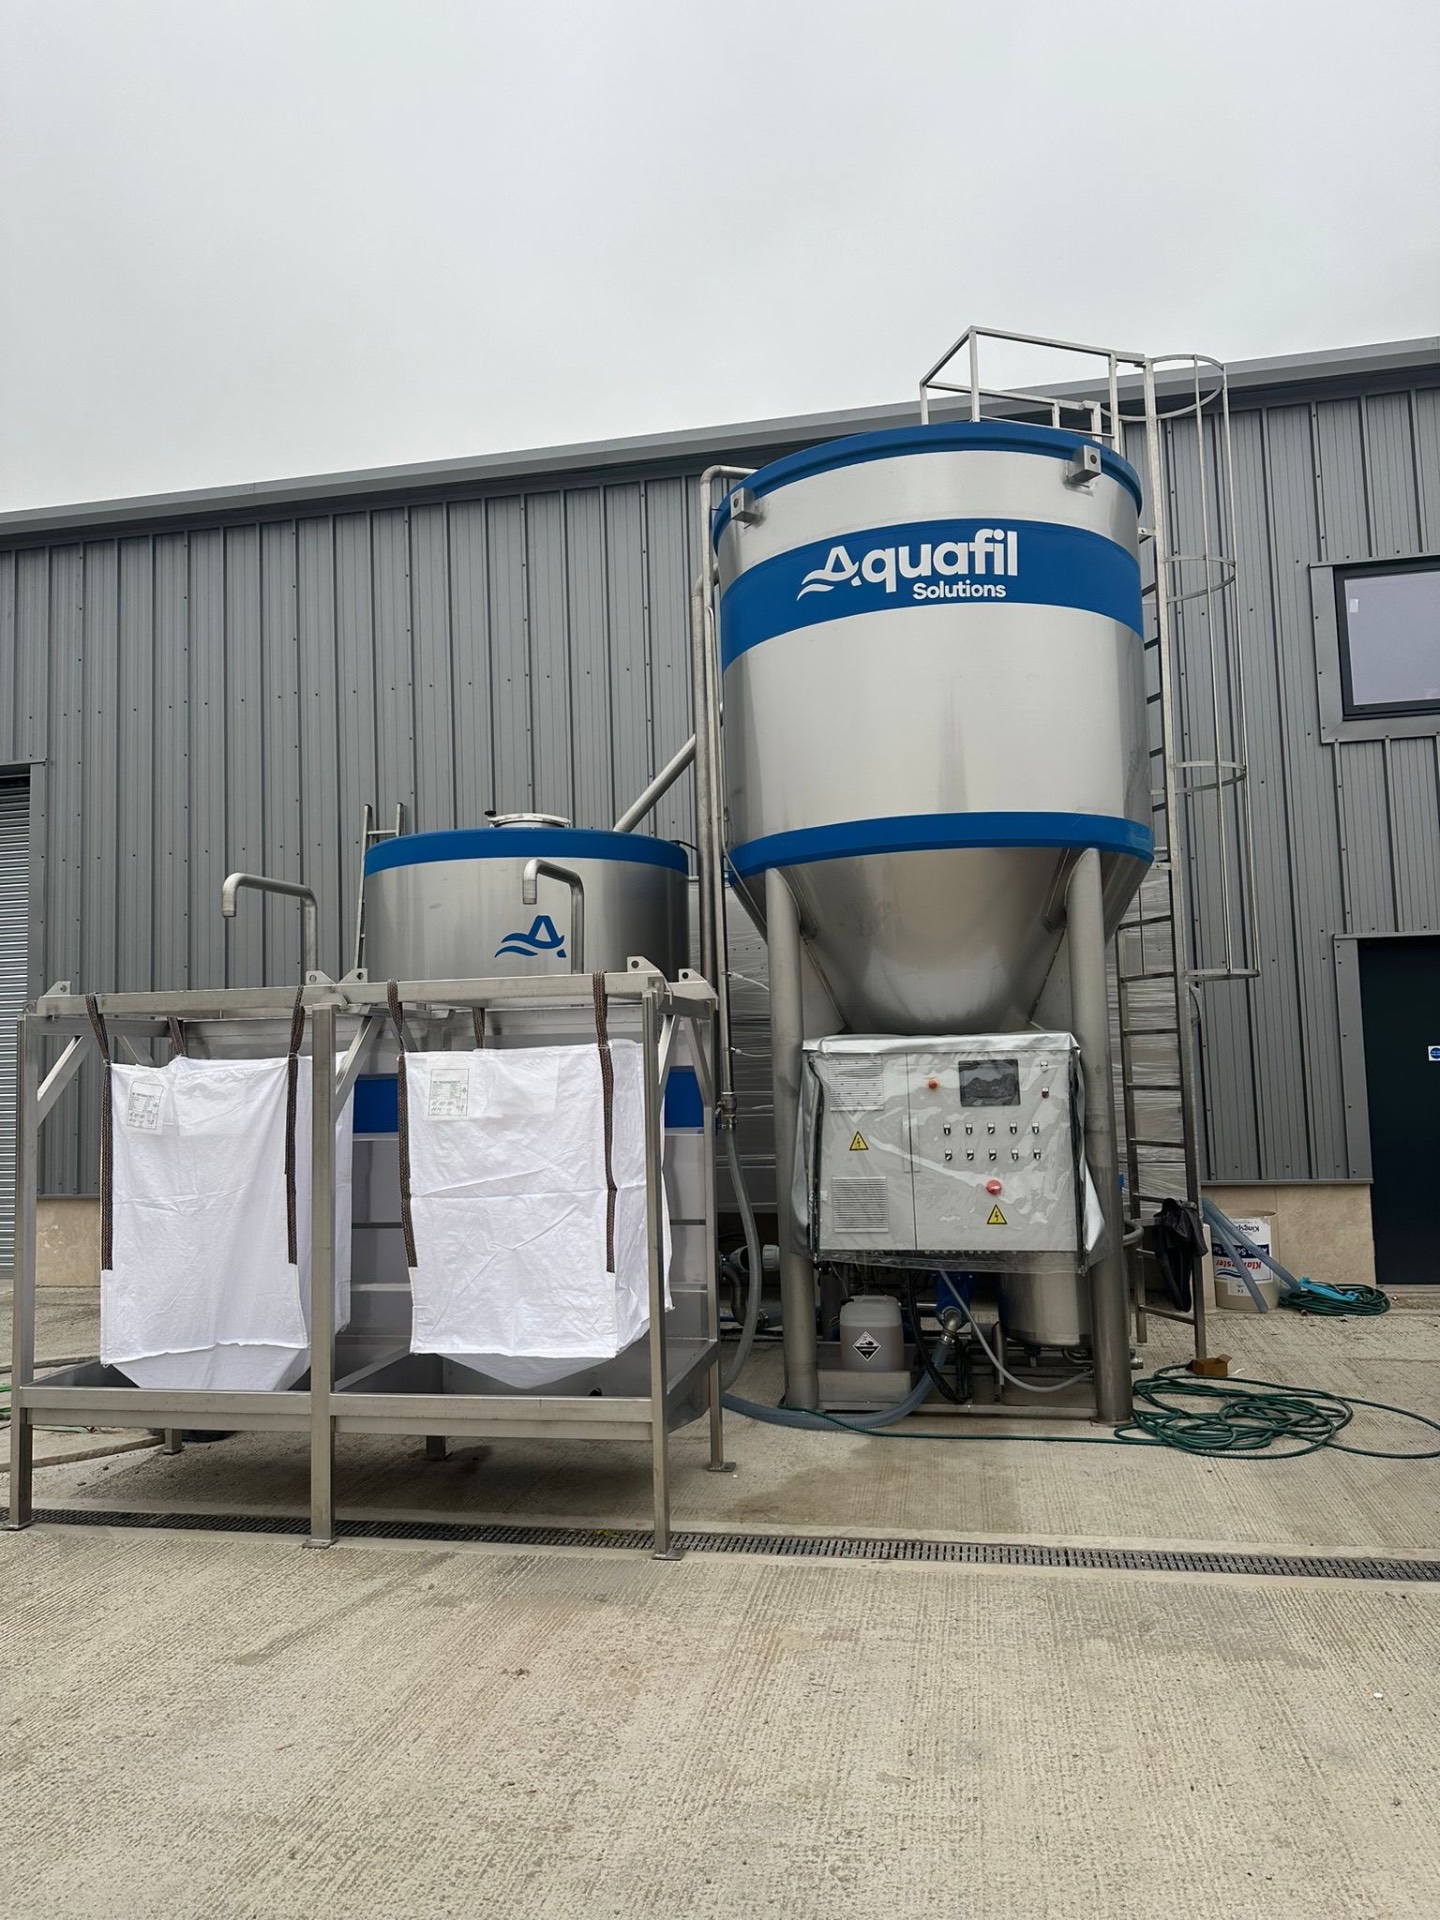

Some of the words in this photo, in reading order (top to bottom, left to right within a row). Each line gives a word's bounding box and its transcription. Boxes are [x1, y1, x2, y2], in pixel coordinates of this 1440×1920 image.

[797, 528, 1018, 601] Aquafil
[912, 579, 1007, 600] Solutions
[1215, 1260, 1261, 1269] Klaester
